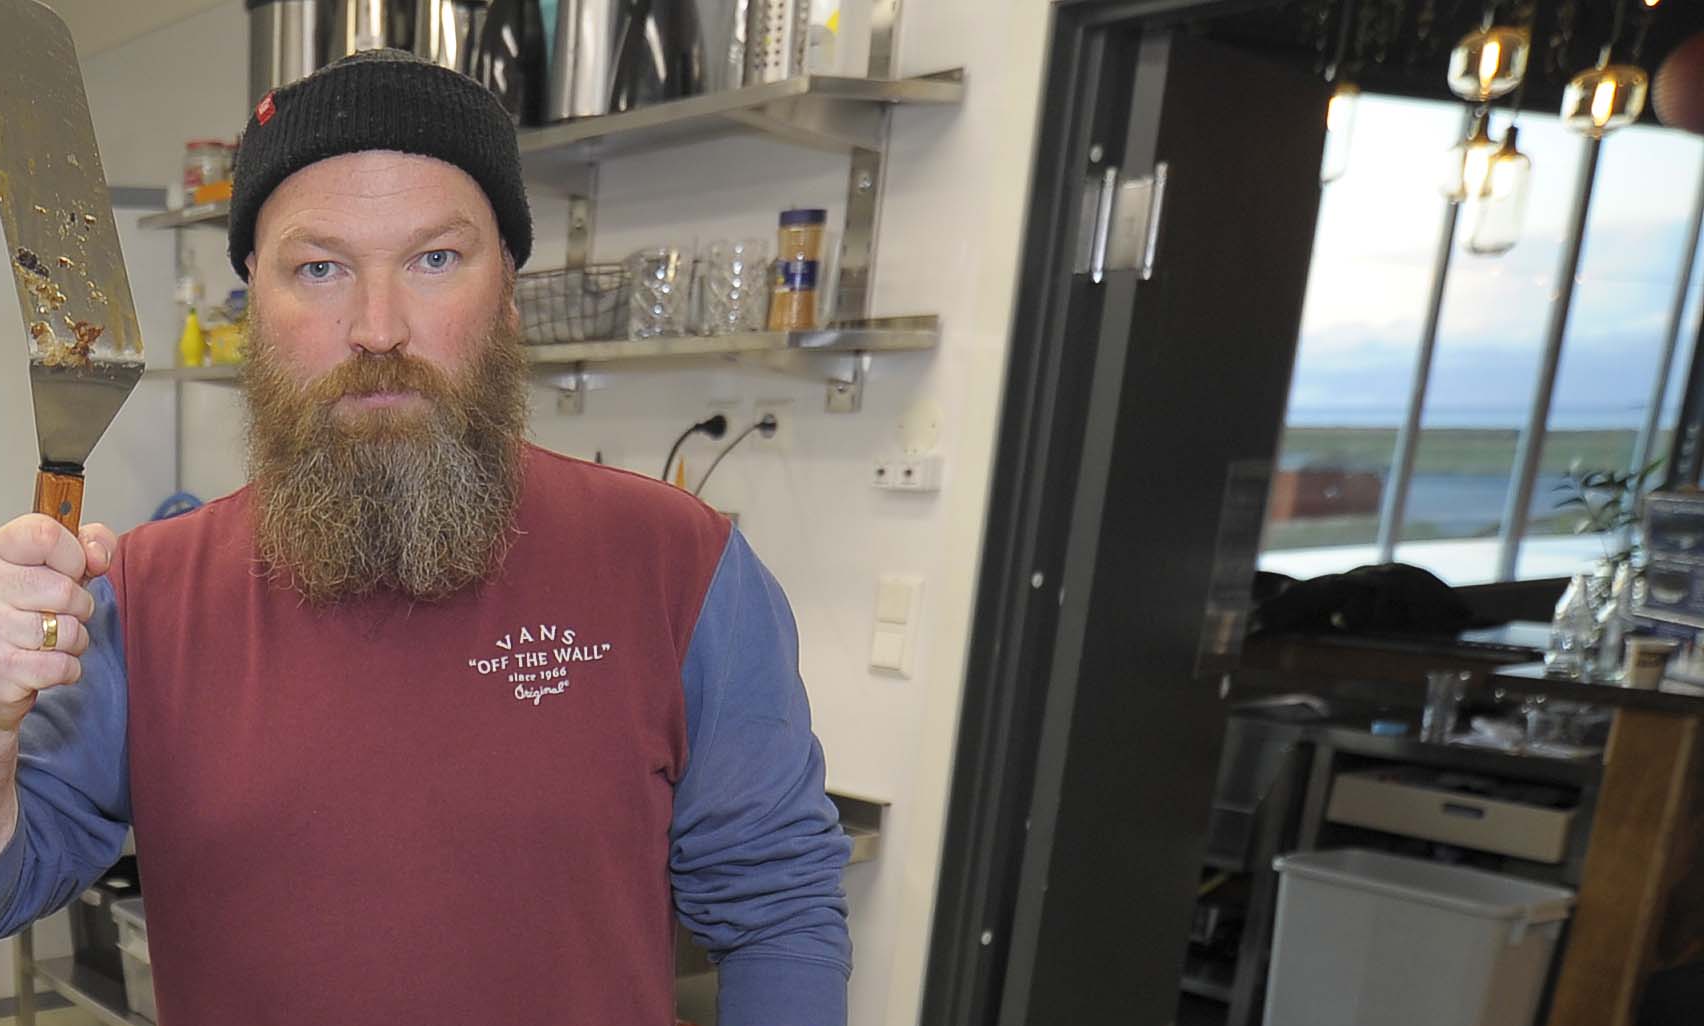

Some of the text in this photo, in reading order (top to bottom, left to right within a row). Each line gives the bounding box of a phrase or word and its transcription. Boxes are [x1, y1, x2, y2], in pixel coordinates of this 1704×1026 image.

[496, 624, 576, 651] VANS
[515, 652, 548, 668] THE
[508, 666, 567, 683] since 1966
